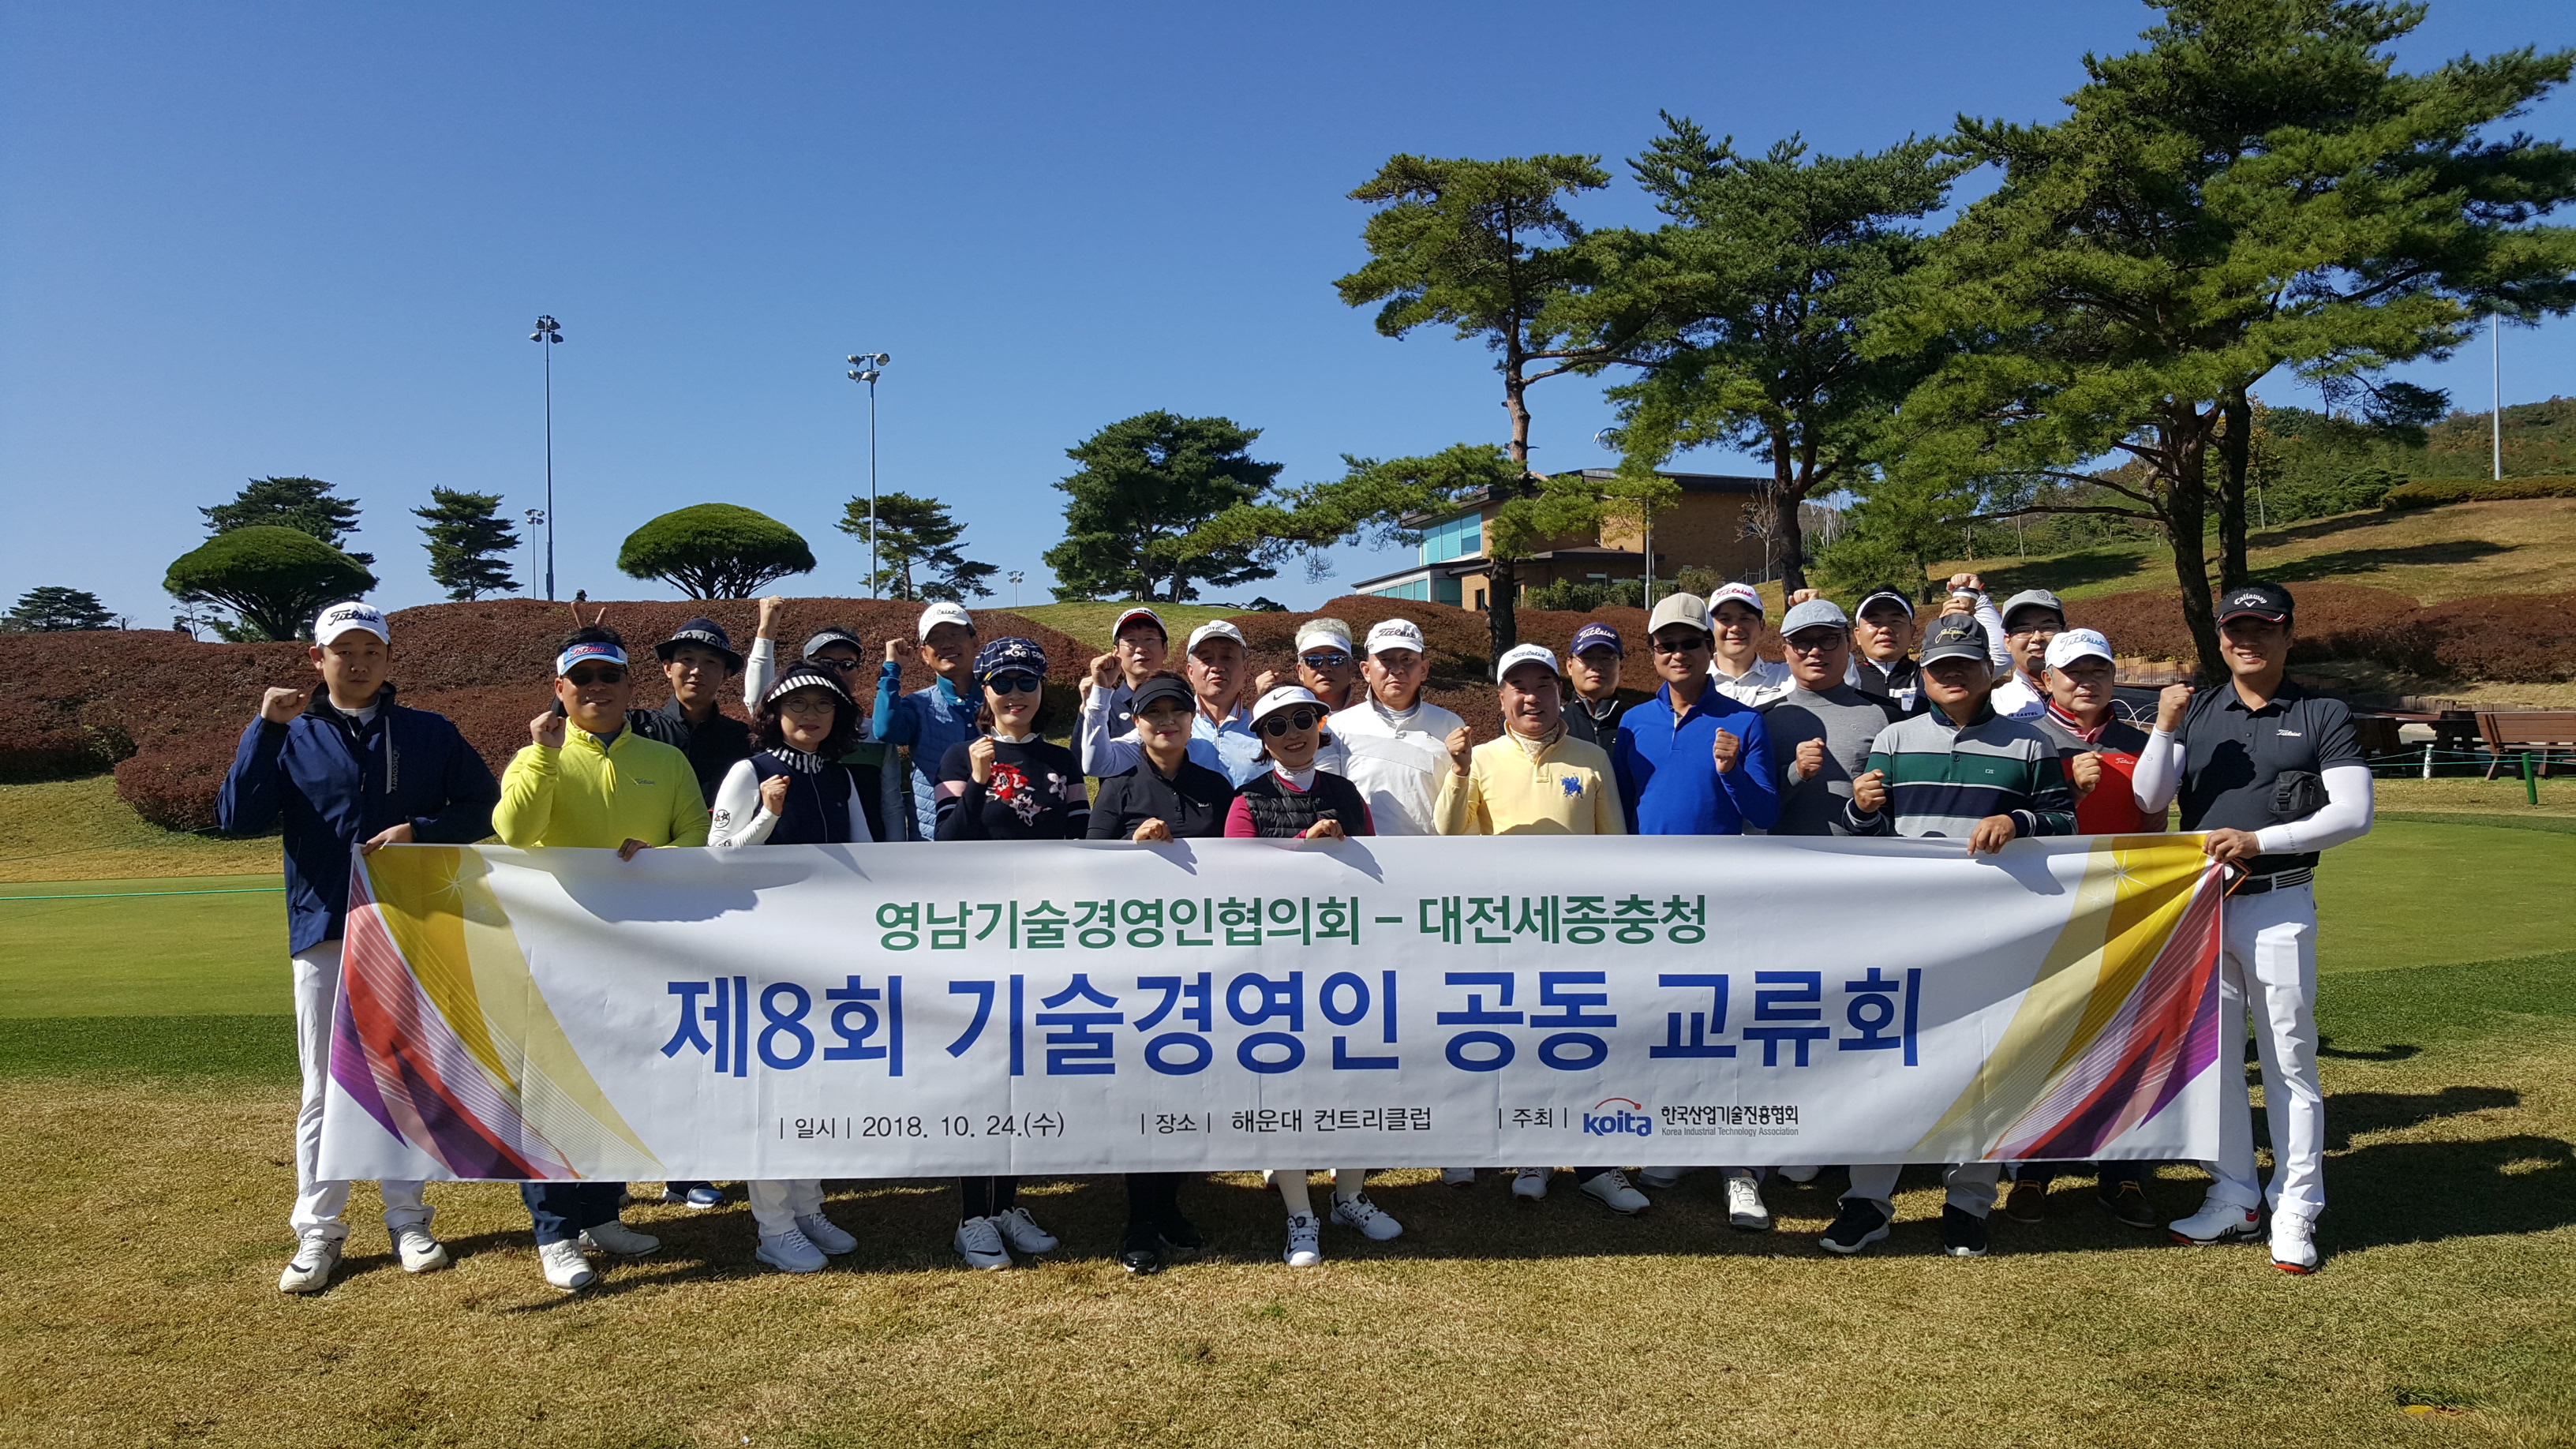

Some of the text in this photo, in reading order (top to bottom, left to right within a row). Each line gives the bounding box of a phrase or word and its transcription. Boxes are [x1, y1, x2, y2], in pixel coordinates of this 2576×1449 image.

[2233, 593, 2267, 605] Callaway
[328, 609, 379, 626] Titleist
[1577, 627, 1616, 642] Titleist
[2060, 633, 2106, 652] Titleist
[391, 753, 400, 791] Discovery
[876, 897, 1360, 951] 영남기술경영인협의회
[1419, 894, 1706, 945] 대전세종충청
[660, 968, 1922, 1078] 제8회 기술경영인 공동 교류회
[796, 1111, 1065, 1139] 일시 2018. 10. 24.(수)
[1155, 1107, 1432, 1135] 장소 해운대 컨트리클럽
[1511, 1108, 1553, 1129] 주최
[1583, 1110, 1653, 1137] koita
[1661, 1105, 1799, 1125] 한국산업기술진흥협회
[1661, 1127, 1799, 1137] Korea Industrial Technology Association
